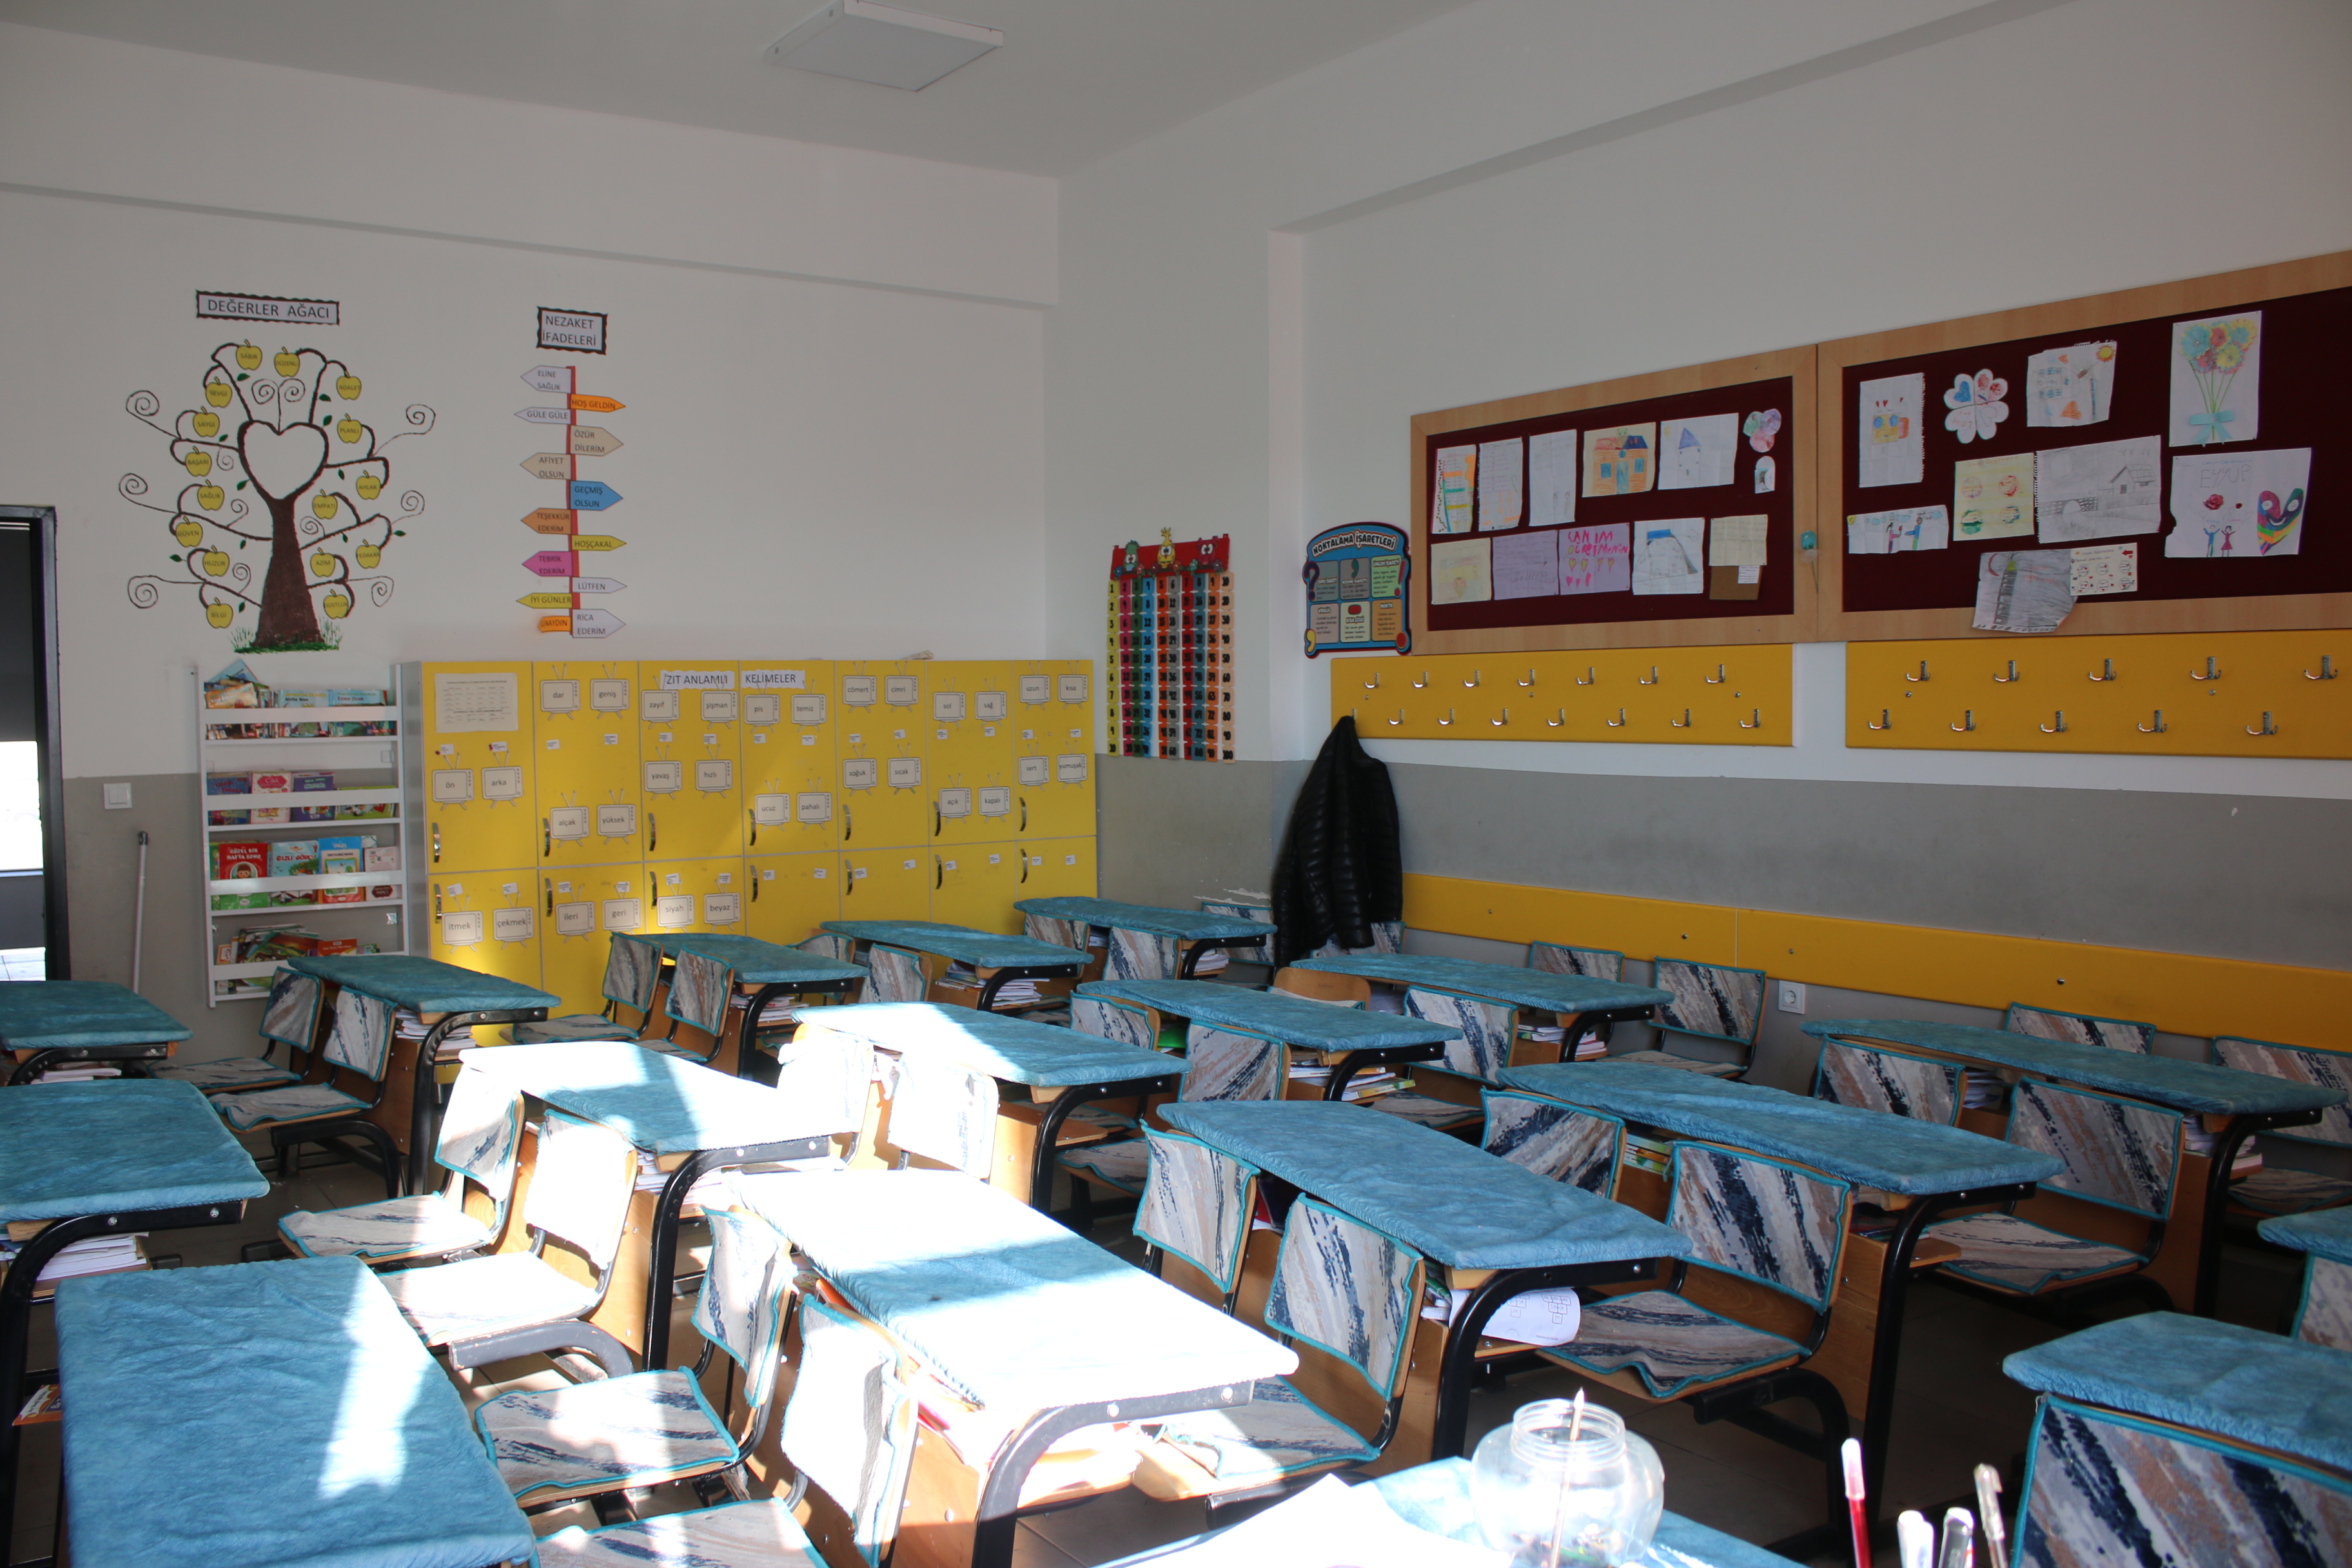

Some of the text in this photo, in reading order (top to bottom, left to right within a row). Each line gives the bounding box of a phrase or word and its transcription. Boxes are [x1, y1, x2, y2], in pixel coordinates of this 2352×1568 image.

[208, 299, 329, 318] DEĞERLER AĞACI
[545, 315, 594, 329] NEZAKET
[542, 332, 596, 346] İFADELERİ
[538, 382, 561, 391] SAĞLIK
[572, 400, 616, 409] HOŞ GELDİN
[527, 410, 568, 419] GÜLE GÜLE
[574, 430, 595, 438] ÖZÜR
[574, 444, 605, 453] DİLERİM
[539, 470, 564, 478] OLSUN
[574, 485, 603, 495] GEÇMİŞ
[536, 512, 569, 521] TEŞEKKÜR
[574, 540, 612, 548] HOŞÇAKAL
[1313, 532, 1396, 554] NOKTALAMA İŞARETLERİ
[666, 672, 796, 684] ZIT ANLAMLI KELİMELER
[599, 690, 616, 699] geniş
[649, 701, 665, 710] zayıf
[706, 701, 728, 710] şişman
[984, 701, 994, 710] sağ
[1059, 762, 1082, 770] yumuşak
[848, 769, 866, 778] soğuk
[985, 797, 1001, 805] kapalı
[801, 803, 820, 812] pahalı
[558, 819, 576, 827] alçak
[602, 816, 625, 825] yüksek
[665, 905, 684, 914] siyah
[710, 905, 730, 913] beyaz
[564, 912, 578, 921] ileri
[612, 909, 626, 919] geri
[448, 922, 471, 930] itmek
[497, 917, 527, 927] çekmek
